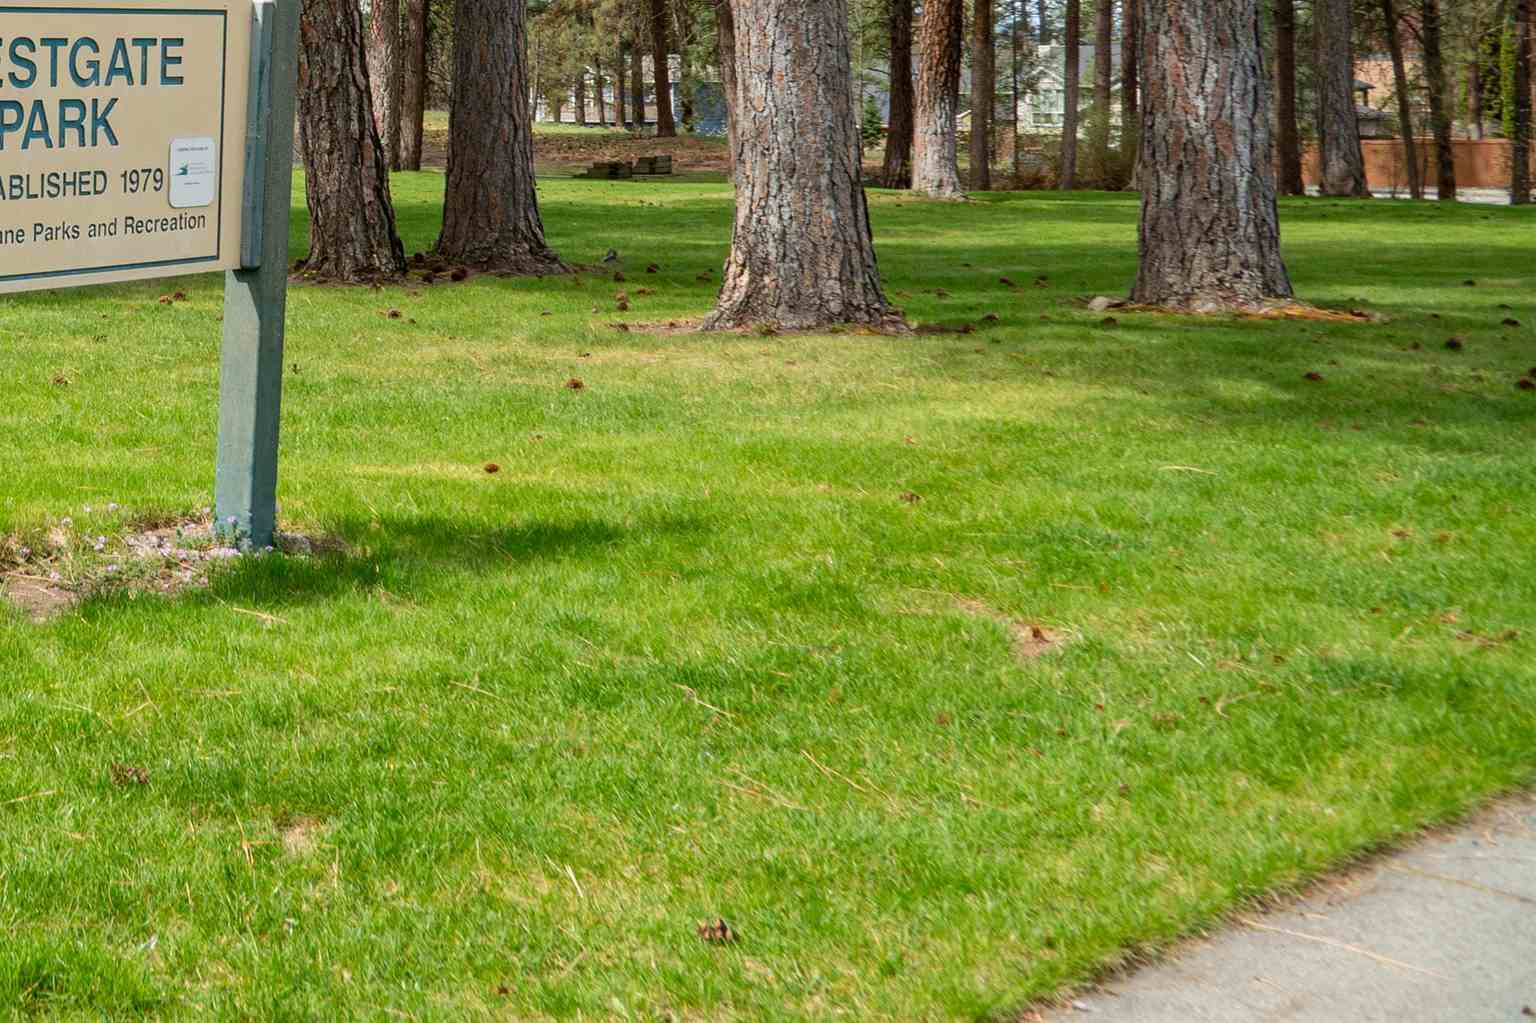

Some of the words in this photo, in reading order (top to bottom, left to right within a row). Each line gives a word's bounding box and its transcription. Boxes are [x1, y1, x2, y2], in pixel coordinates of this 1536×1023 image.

[121, 168, 163, 193] 1979
[32, 220, 81, 242] Parks
[88, 217, 117, 237] and
[124, 213, 206, 235] Recreation
